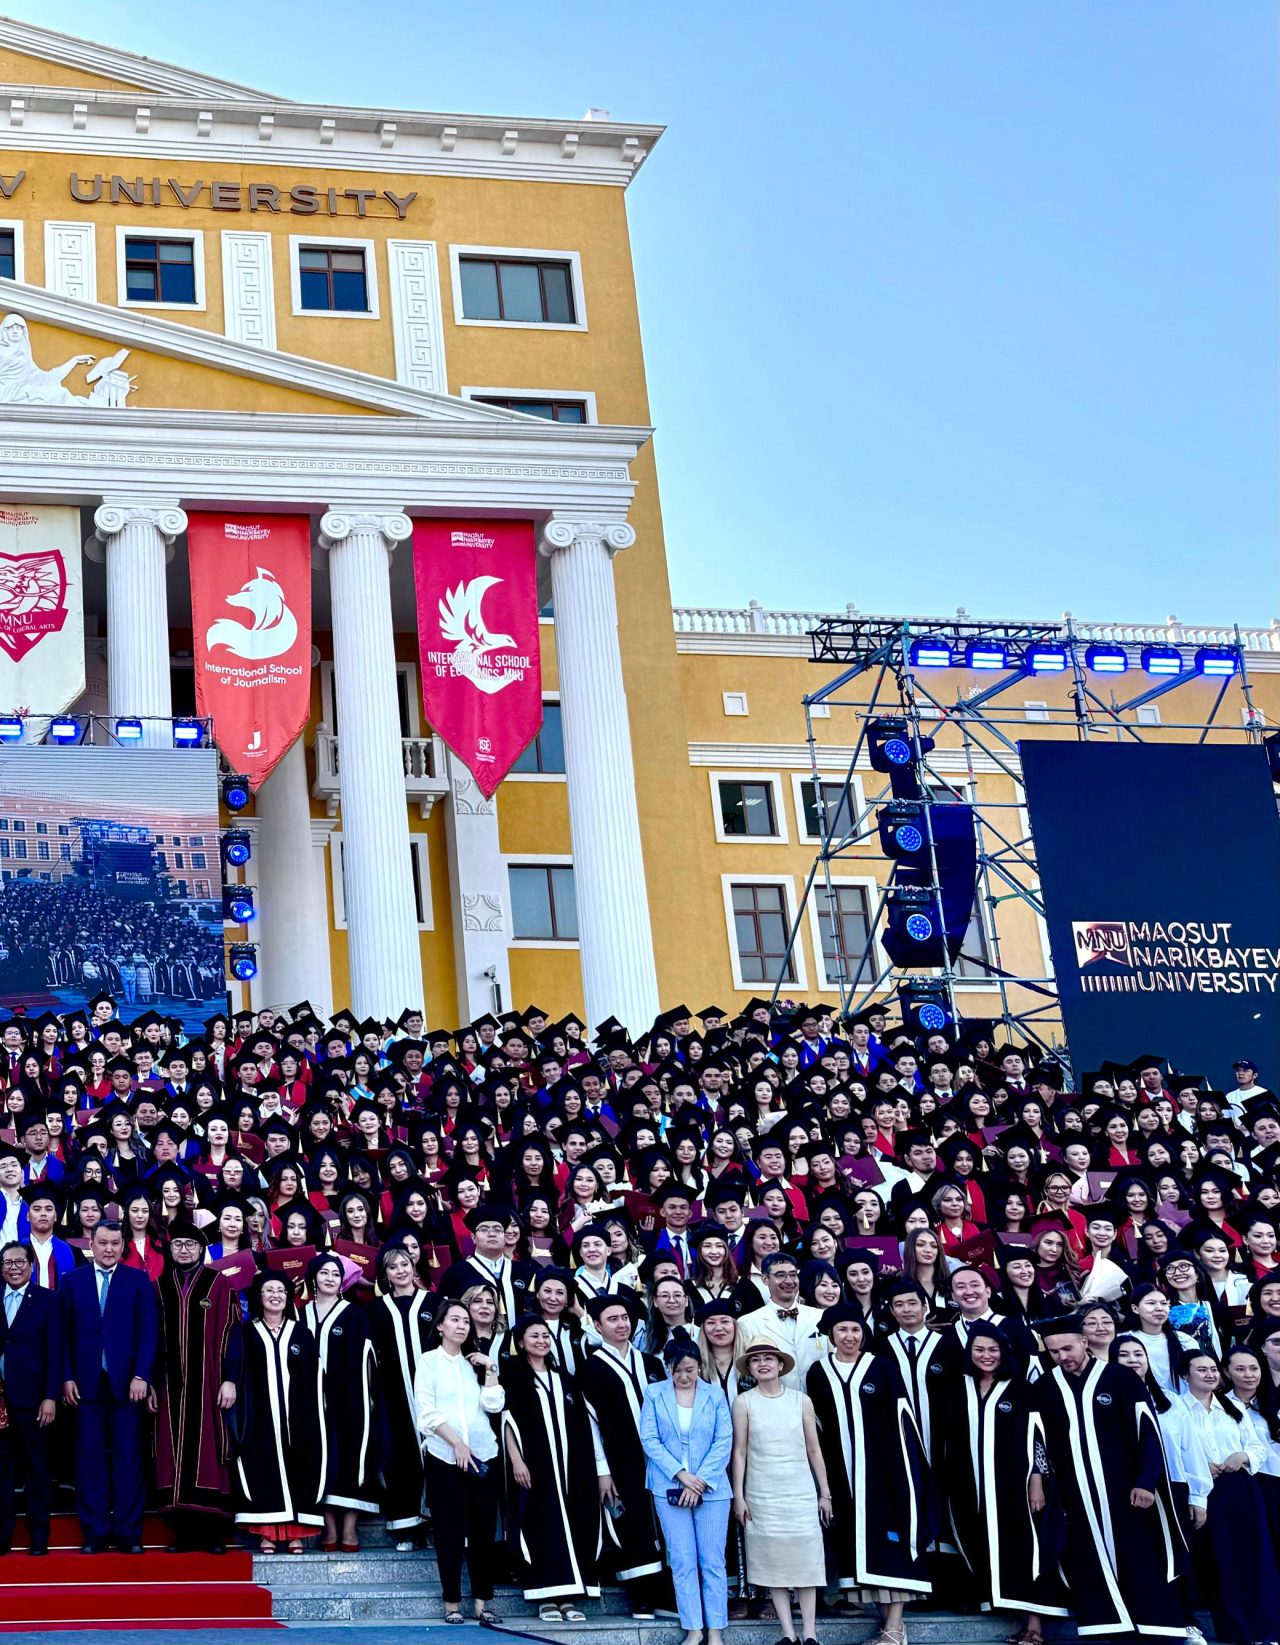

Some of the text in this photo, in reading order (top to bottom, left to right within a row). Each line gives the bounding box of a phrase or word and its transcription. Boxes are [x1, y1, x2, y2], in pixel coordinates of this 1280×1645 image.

[70, 172, 418, 219] UNIVERSITY
[0, 613, 33, 627] MNU
[13, 624, 37, 633] LIBERAL
[204, 661, 302, 677] International School
[427, 651, 532, 669] INTERNATNAL SCHOOL
[220, 675, 287, 688] of Journalism
[435, 664, 524, 681] OF ECONMICS MNU
[1076, 928, 1129, 952] MNU
[1128, 921, 1233, 946] MAQSUT
[1132, 946, 1280, 969] NARIKBAYEV
[1136, 971, 1279, 994] UNIVERSITY
